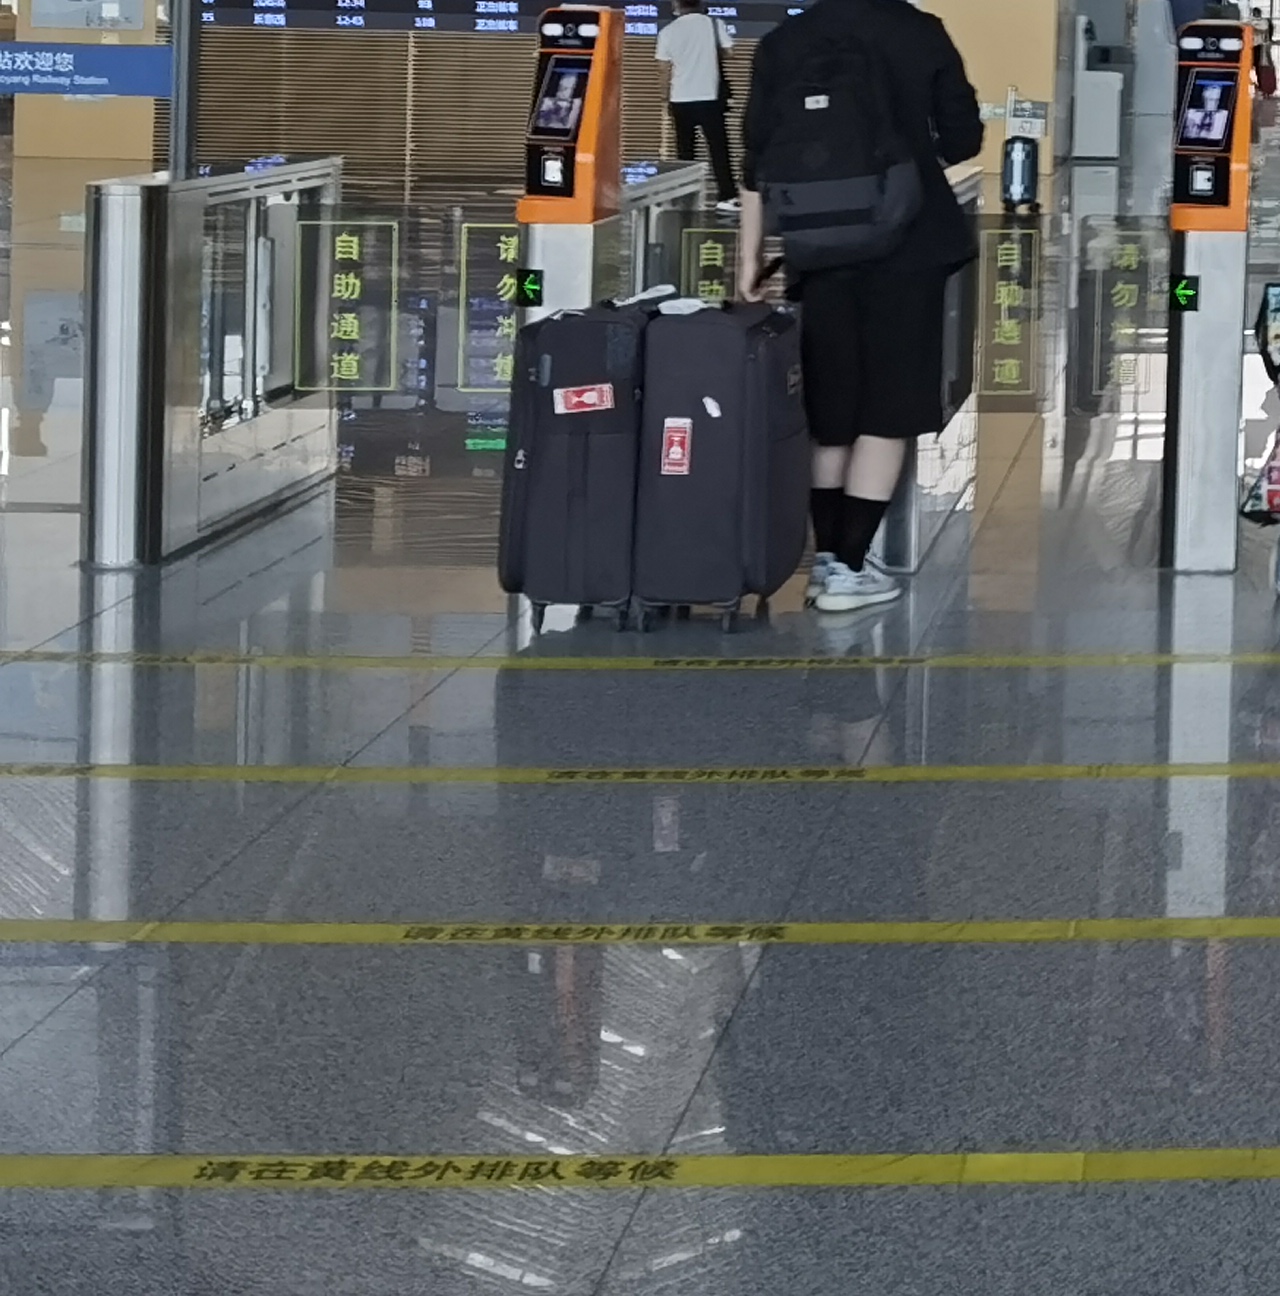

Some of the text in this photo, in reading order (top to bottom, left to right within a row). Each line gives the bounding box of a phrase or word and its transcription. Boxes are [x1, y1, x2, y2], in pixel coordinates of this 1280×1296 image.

[32, 74, 71, 87] Railway
[73, 75, 109, 86] Station
[698, 239, 726, 302] 自助
[331, 233, 361, 380] 自助通道
[194, 1159, 681, 1184] 请在黄线外排队等候
